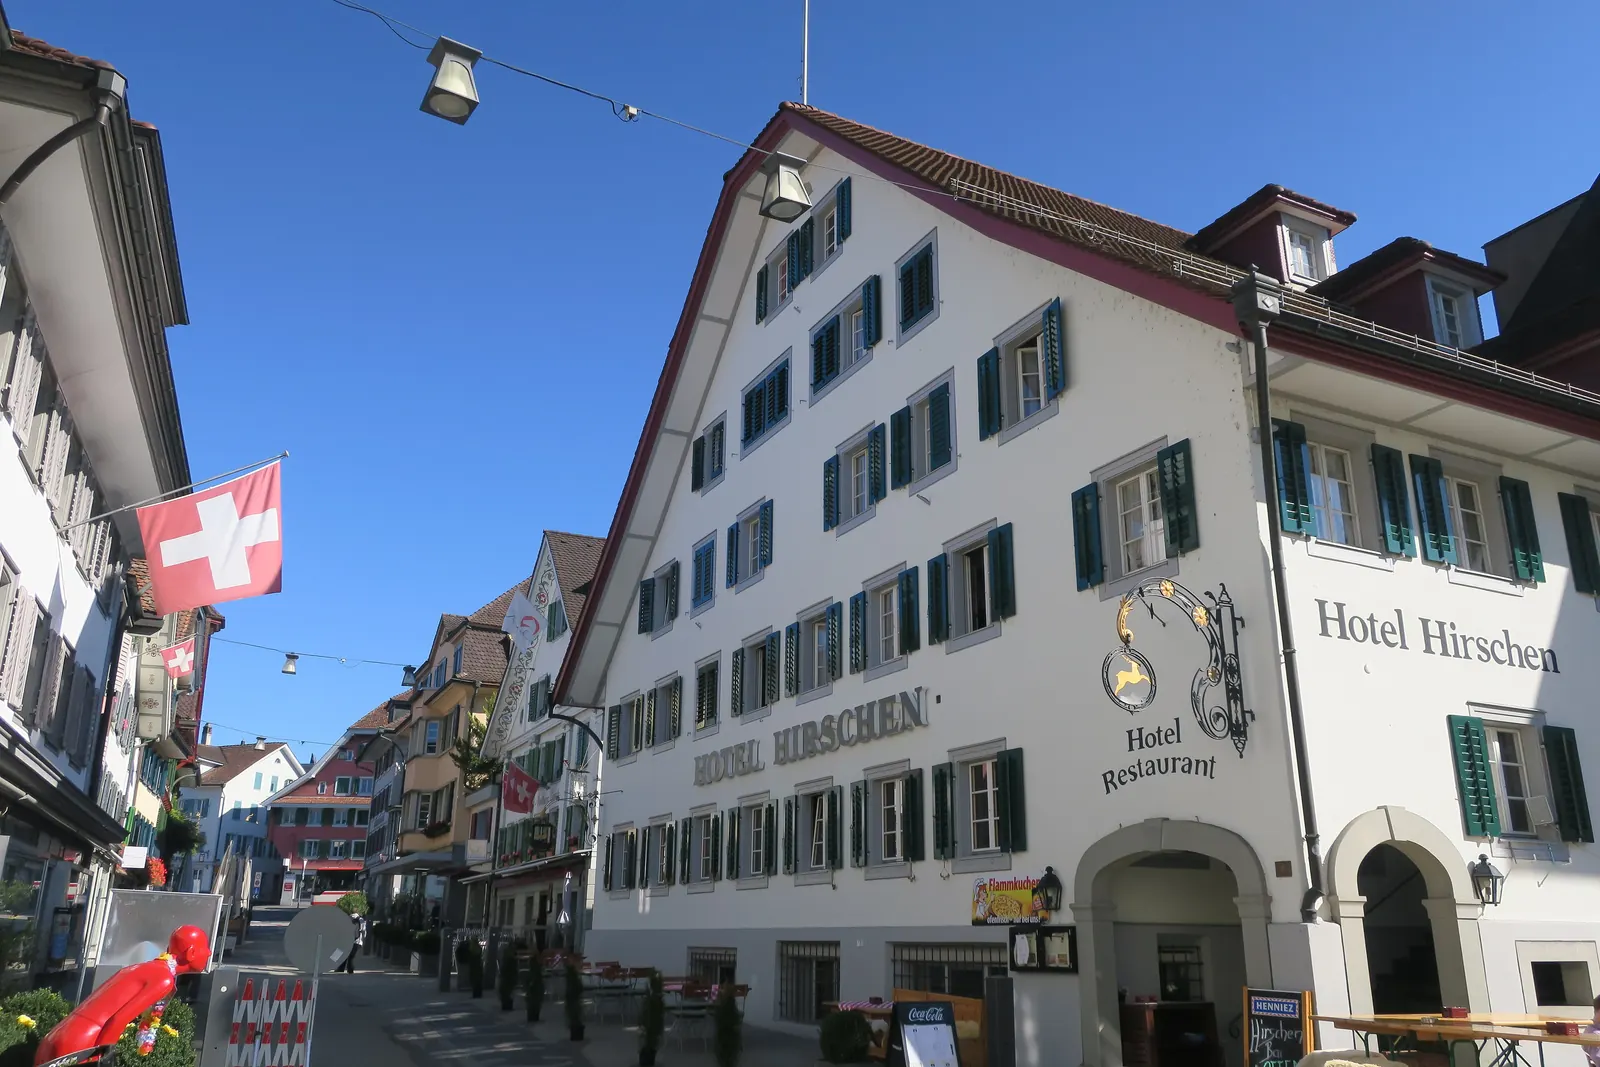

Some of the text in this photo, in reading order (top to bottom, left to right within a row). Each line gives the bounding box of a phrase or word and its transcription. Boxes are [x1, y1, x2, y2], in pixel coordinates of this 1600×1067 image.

[1314, 598, 1561, 673] Hotel Hirschen
[693, 686, 929, 786] HOTEL HIRSCHEN
[1126, 717, 1181, 752] Hotel
[1102, 756, 1216, 795] Restaurant
[908, 1007, 944, 1021] Coca-Cola
[1256, 1001, 1294, 1013] HENNIEZ
[1250, 1019, 1303, 1053] Hirschen
